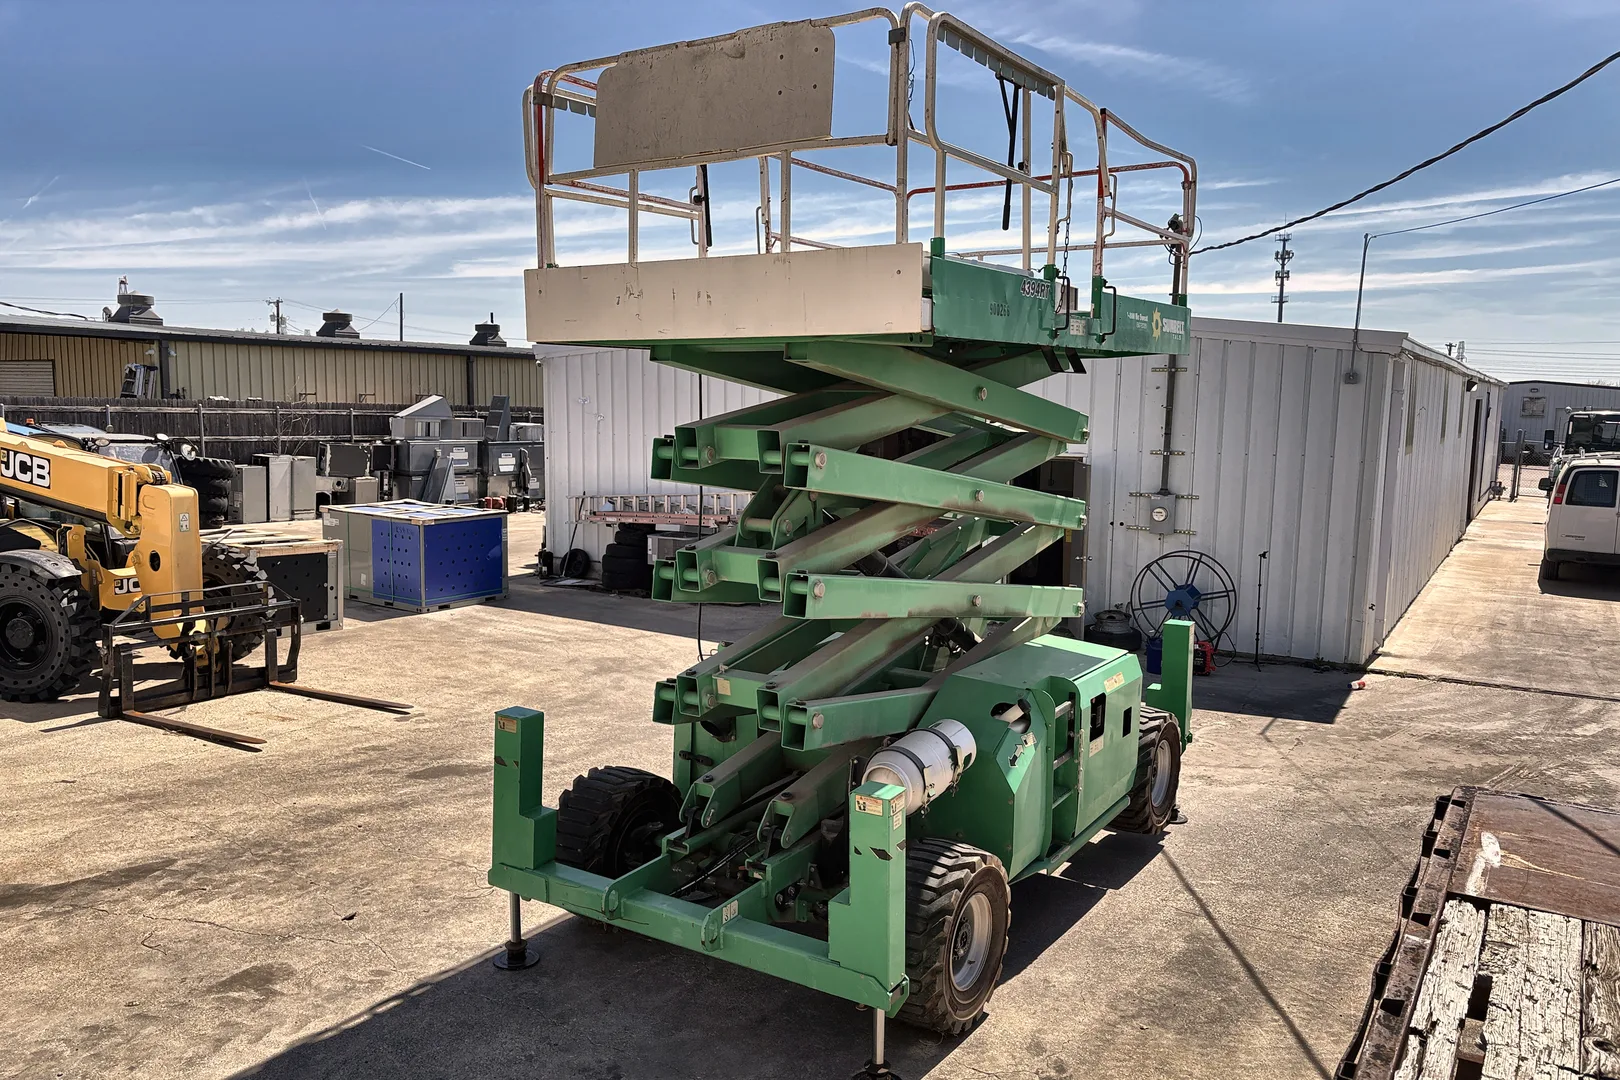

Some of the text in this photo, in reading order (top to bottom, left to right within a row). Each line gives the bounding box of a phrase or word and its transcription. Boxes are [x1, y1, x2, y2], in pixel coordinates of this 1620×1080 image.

[1020, 279, 1050, 299] 4394RT
[1, 450, 50, 487] JCB
[115, 577, 141, 594] JC
